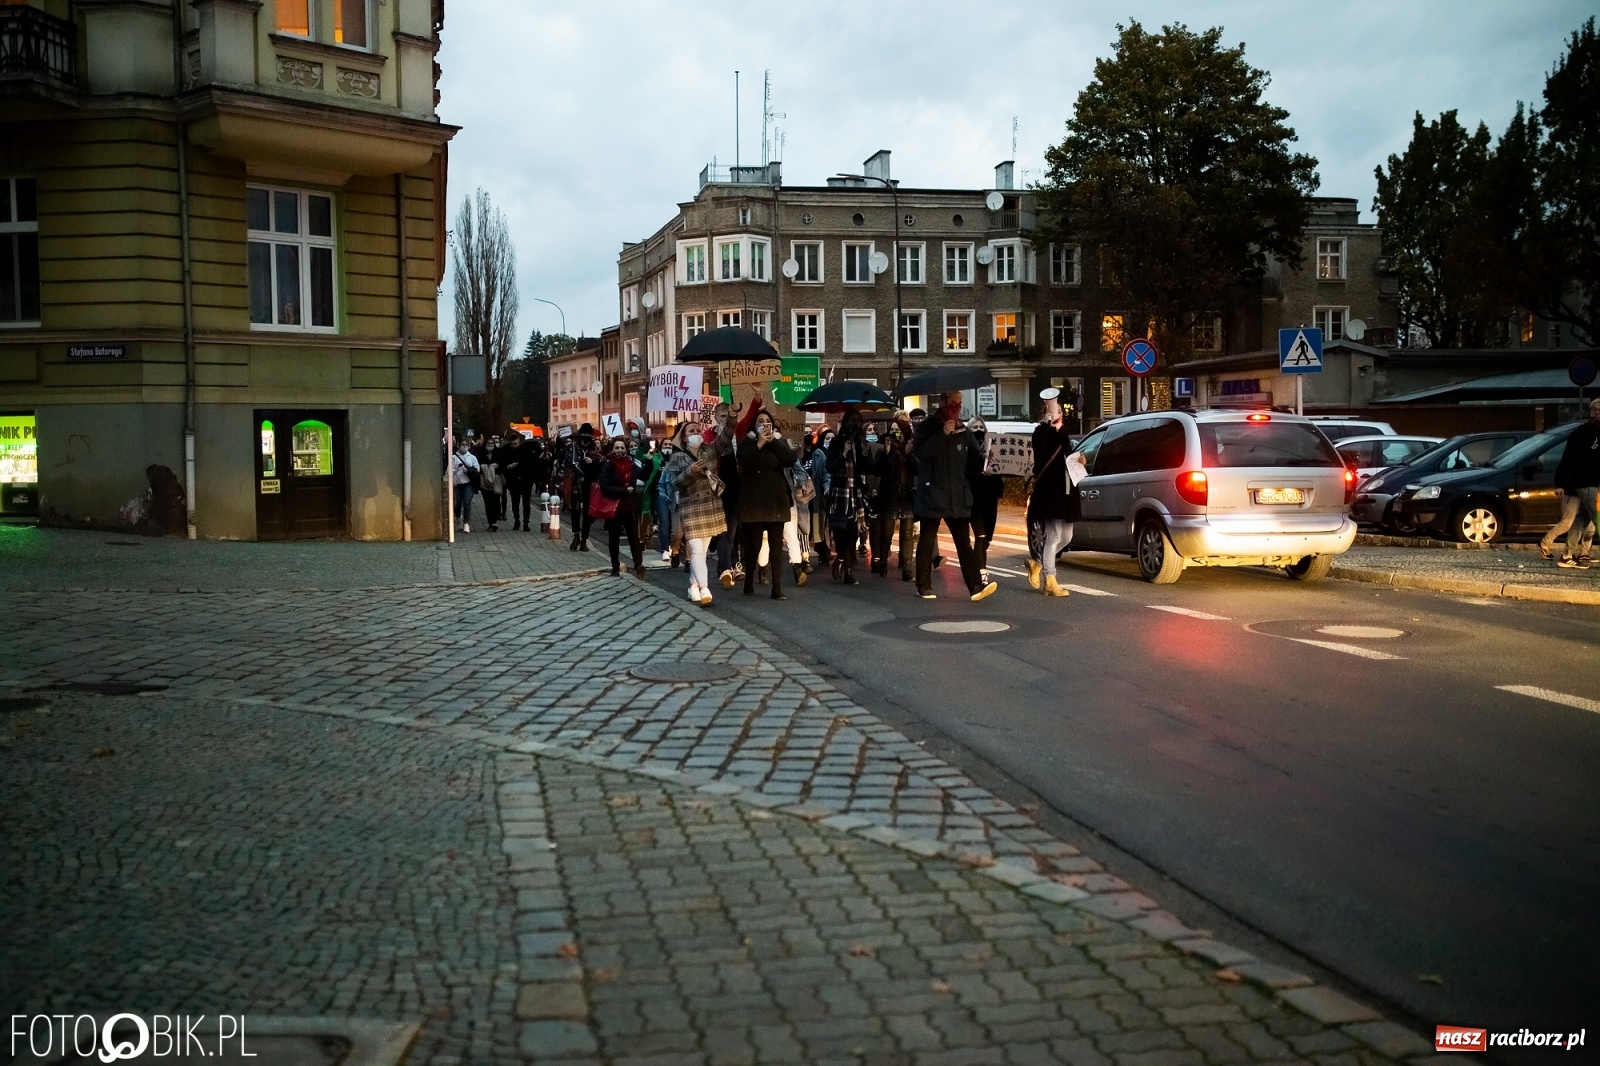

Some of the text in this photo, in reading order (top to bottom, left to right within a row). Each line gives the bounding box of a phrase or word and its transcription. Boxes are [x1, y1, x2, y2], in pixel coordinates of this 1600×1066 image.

[70, 346, 122, 357] Stefana Batorego
[649, 370, 679, 387] WYBÓR
[723, 365, 782, 379] FEMINISTS
[664, 386, 679, 398] NIE
[1181, 380, 1191, 394] L
[1260, 492, 1304, 502] SRC 9GU3
